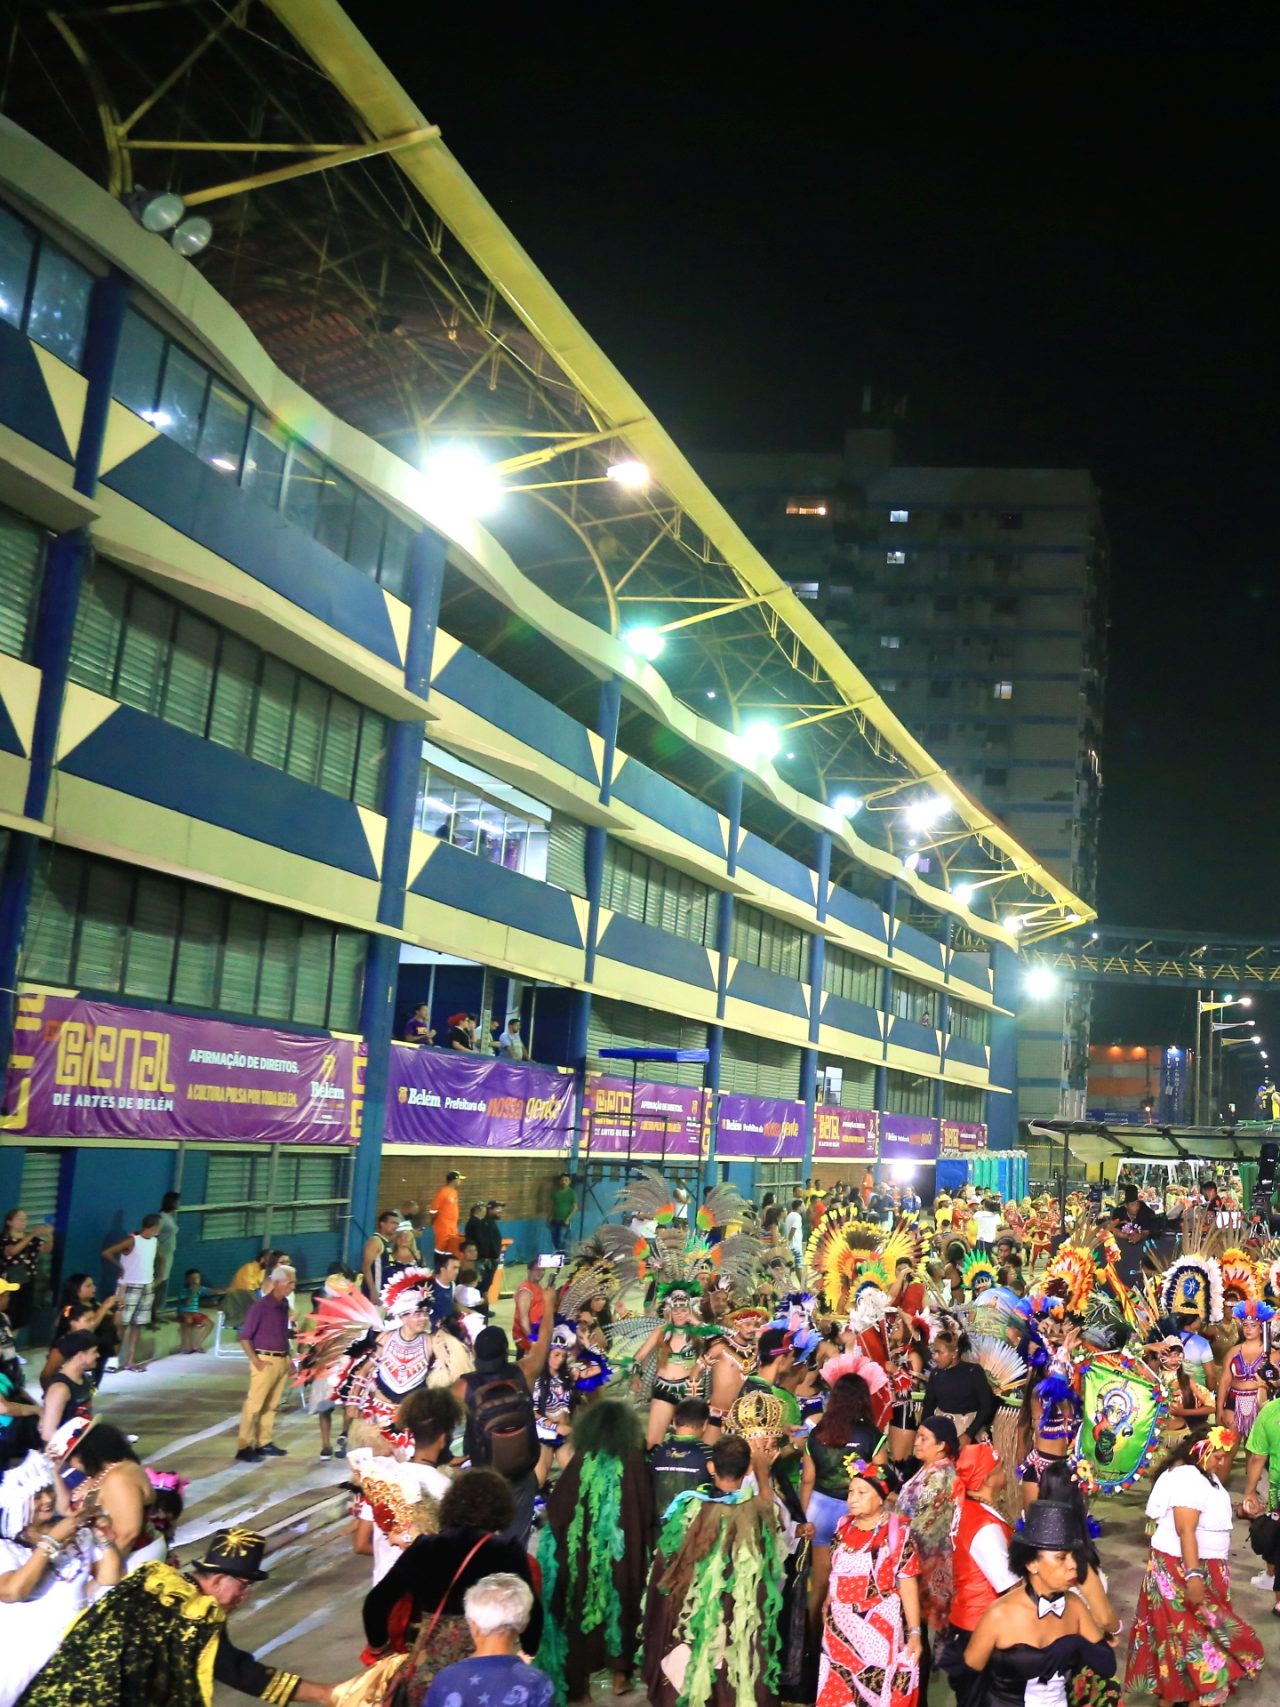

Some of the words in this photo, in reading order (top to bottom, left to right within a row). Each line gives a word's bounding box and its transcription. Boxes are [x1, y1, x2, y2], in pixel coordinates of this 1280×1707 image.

[189, 1049, 245, 1069] AFIRMAÇÃO
[247, 1056, 260, 1069] DE
[310, 1081, 345, 1100] Belém
[408, 1087, 441, 1107] Belém
[444, 1097, 476, 1112] Prefeitura
[53, 1093, 71, 1106] DE
[75, 1094, 115, 1109] ARTES
[118, 1096, 133, 1109] DE
[137, 1096, 173, 1112] BELÉM
